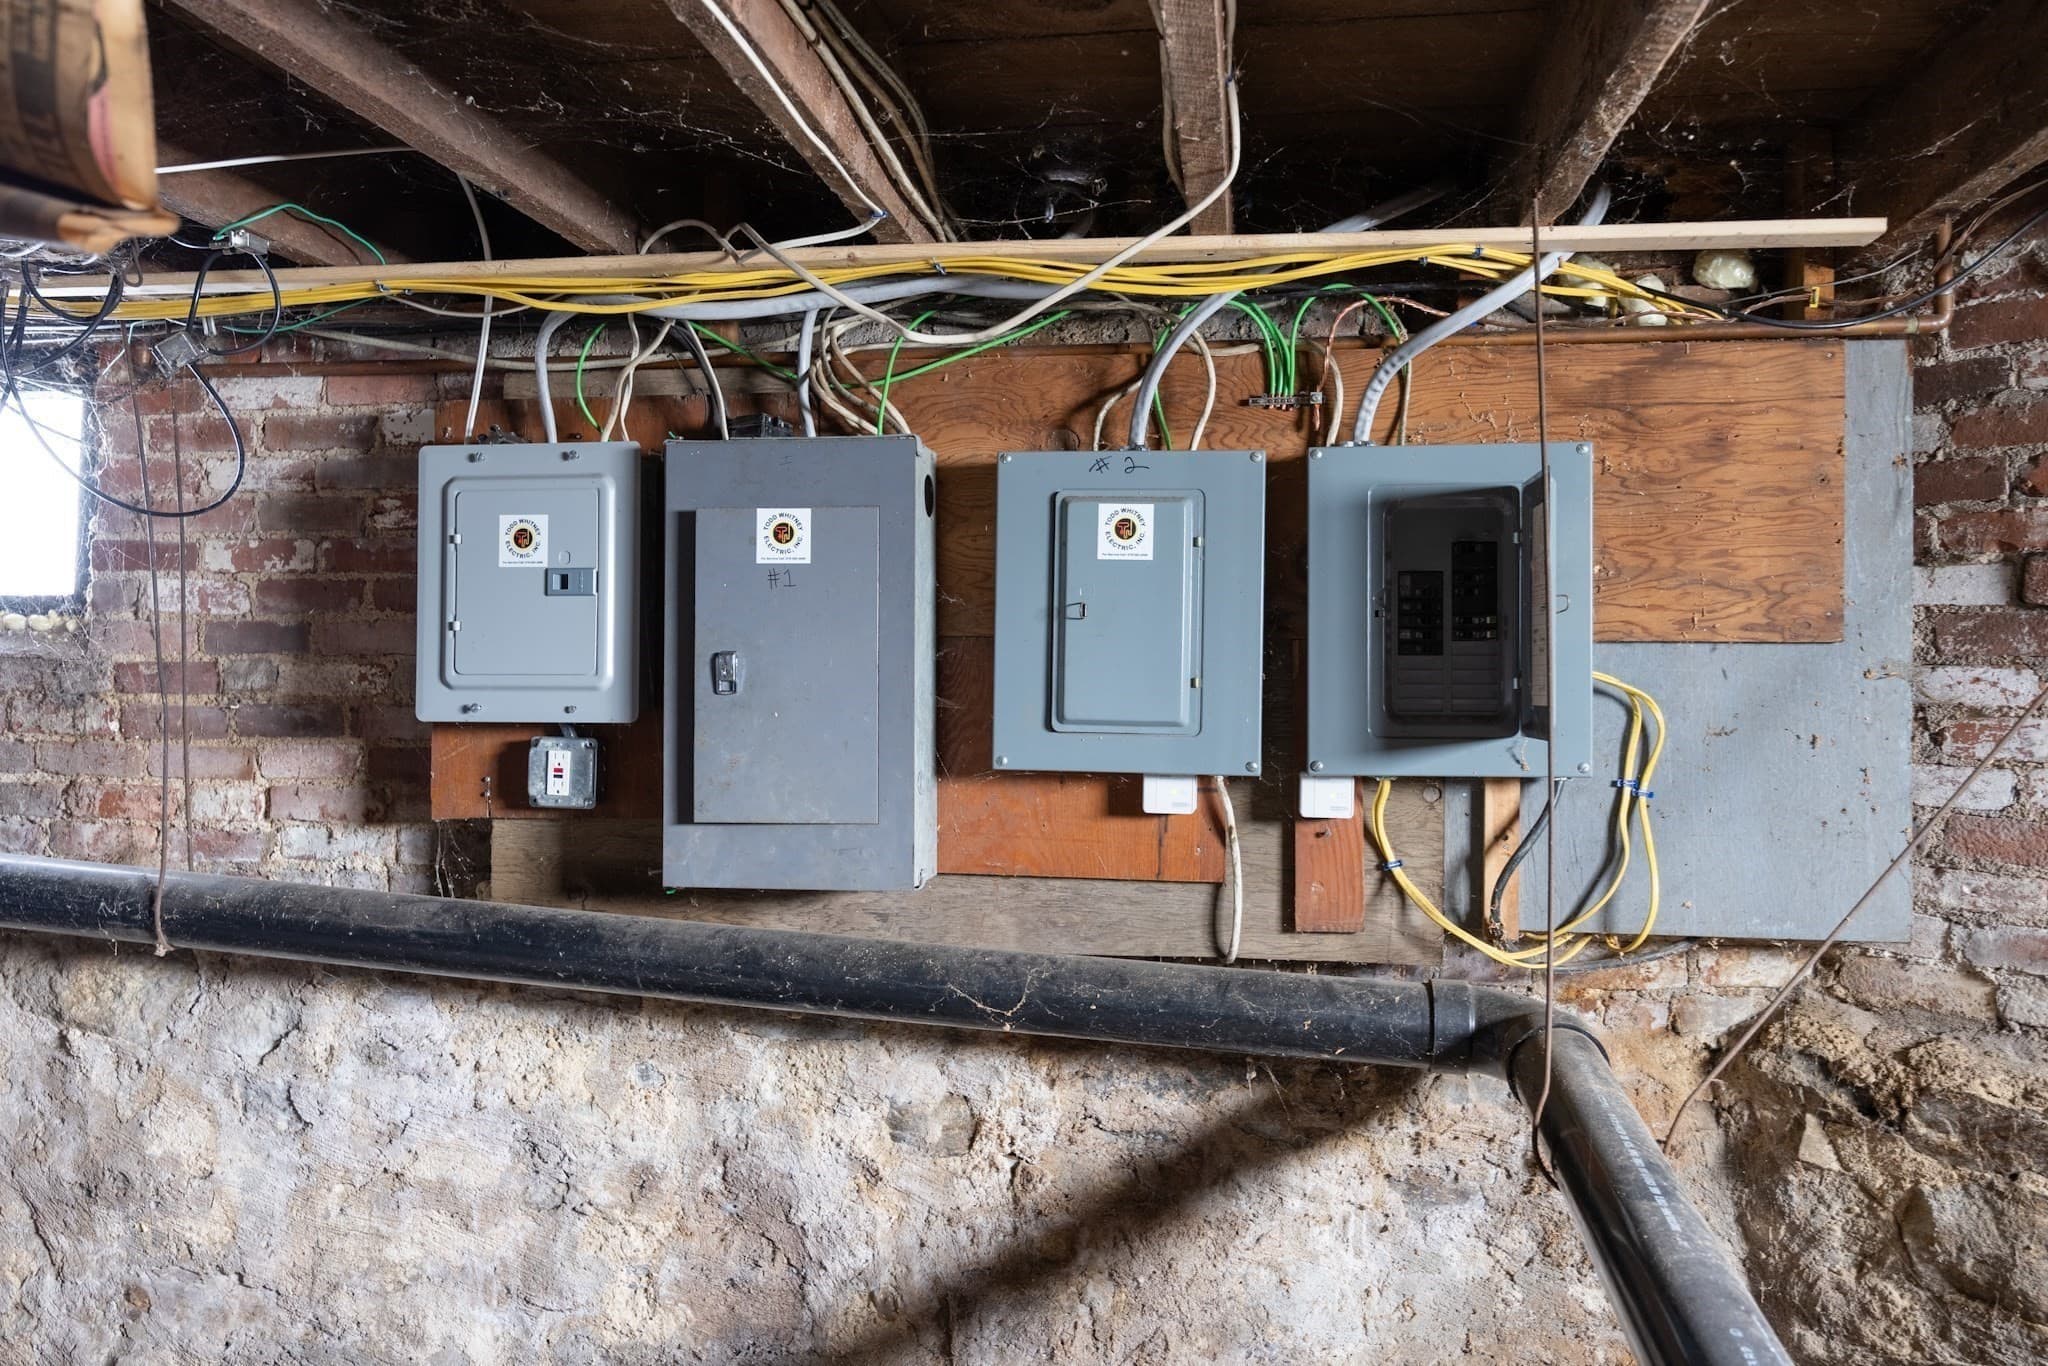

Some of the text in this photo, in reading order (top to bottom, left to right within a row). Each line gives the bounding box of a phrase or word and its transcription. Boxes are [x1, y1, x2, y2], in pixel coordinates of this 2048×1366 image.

[763, 512, 804, 530] TODD WHITNEY
[1105, 508, 1146, 527] TODD WHITNEY
